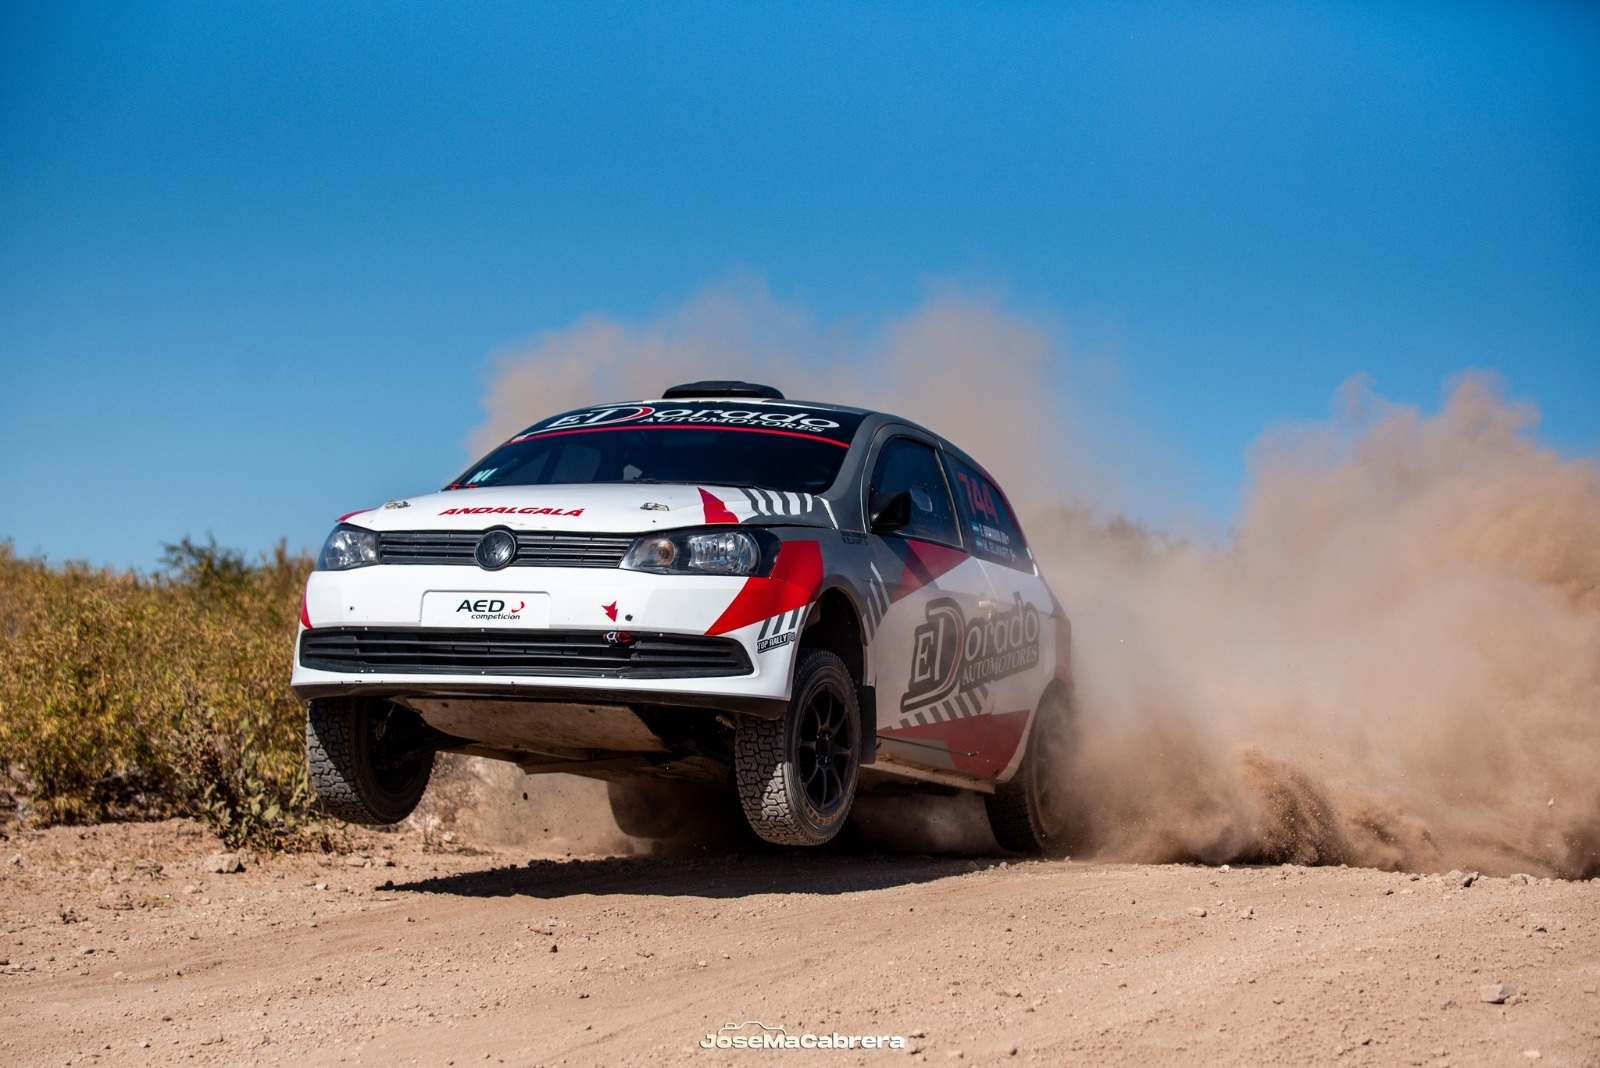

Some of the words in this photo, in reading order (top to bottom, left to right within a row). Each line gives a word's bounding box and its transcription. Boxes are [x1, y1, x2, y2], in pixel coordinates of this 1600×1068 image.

[638, 417, 825, 433] AUTOMOTORES
[957, 471, 1000, 525] 744
[437, 507, 587, 517] ANDALGALÁ
[456, 599, 505, 613] AED
[471, 613, 521, 621] competición
[757, 640, 769, 650] TOP
[769, 634, 787, 647] RALLY
[962, 645, 1037, 685] AUTOMOTORES
